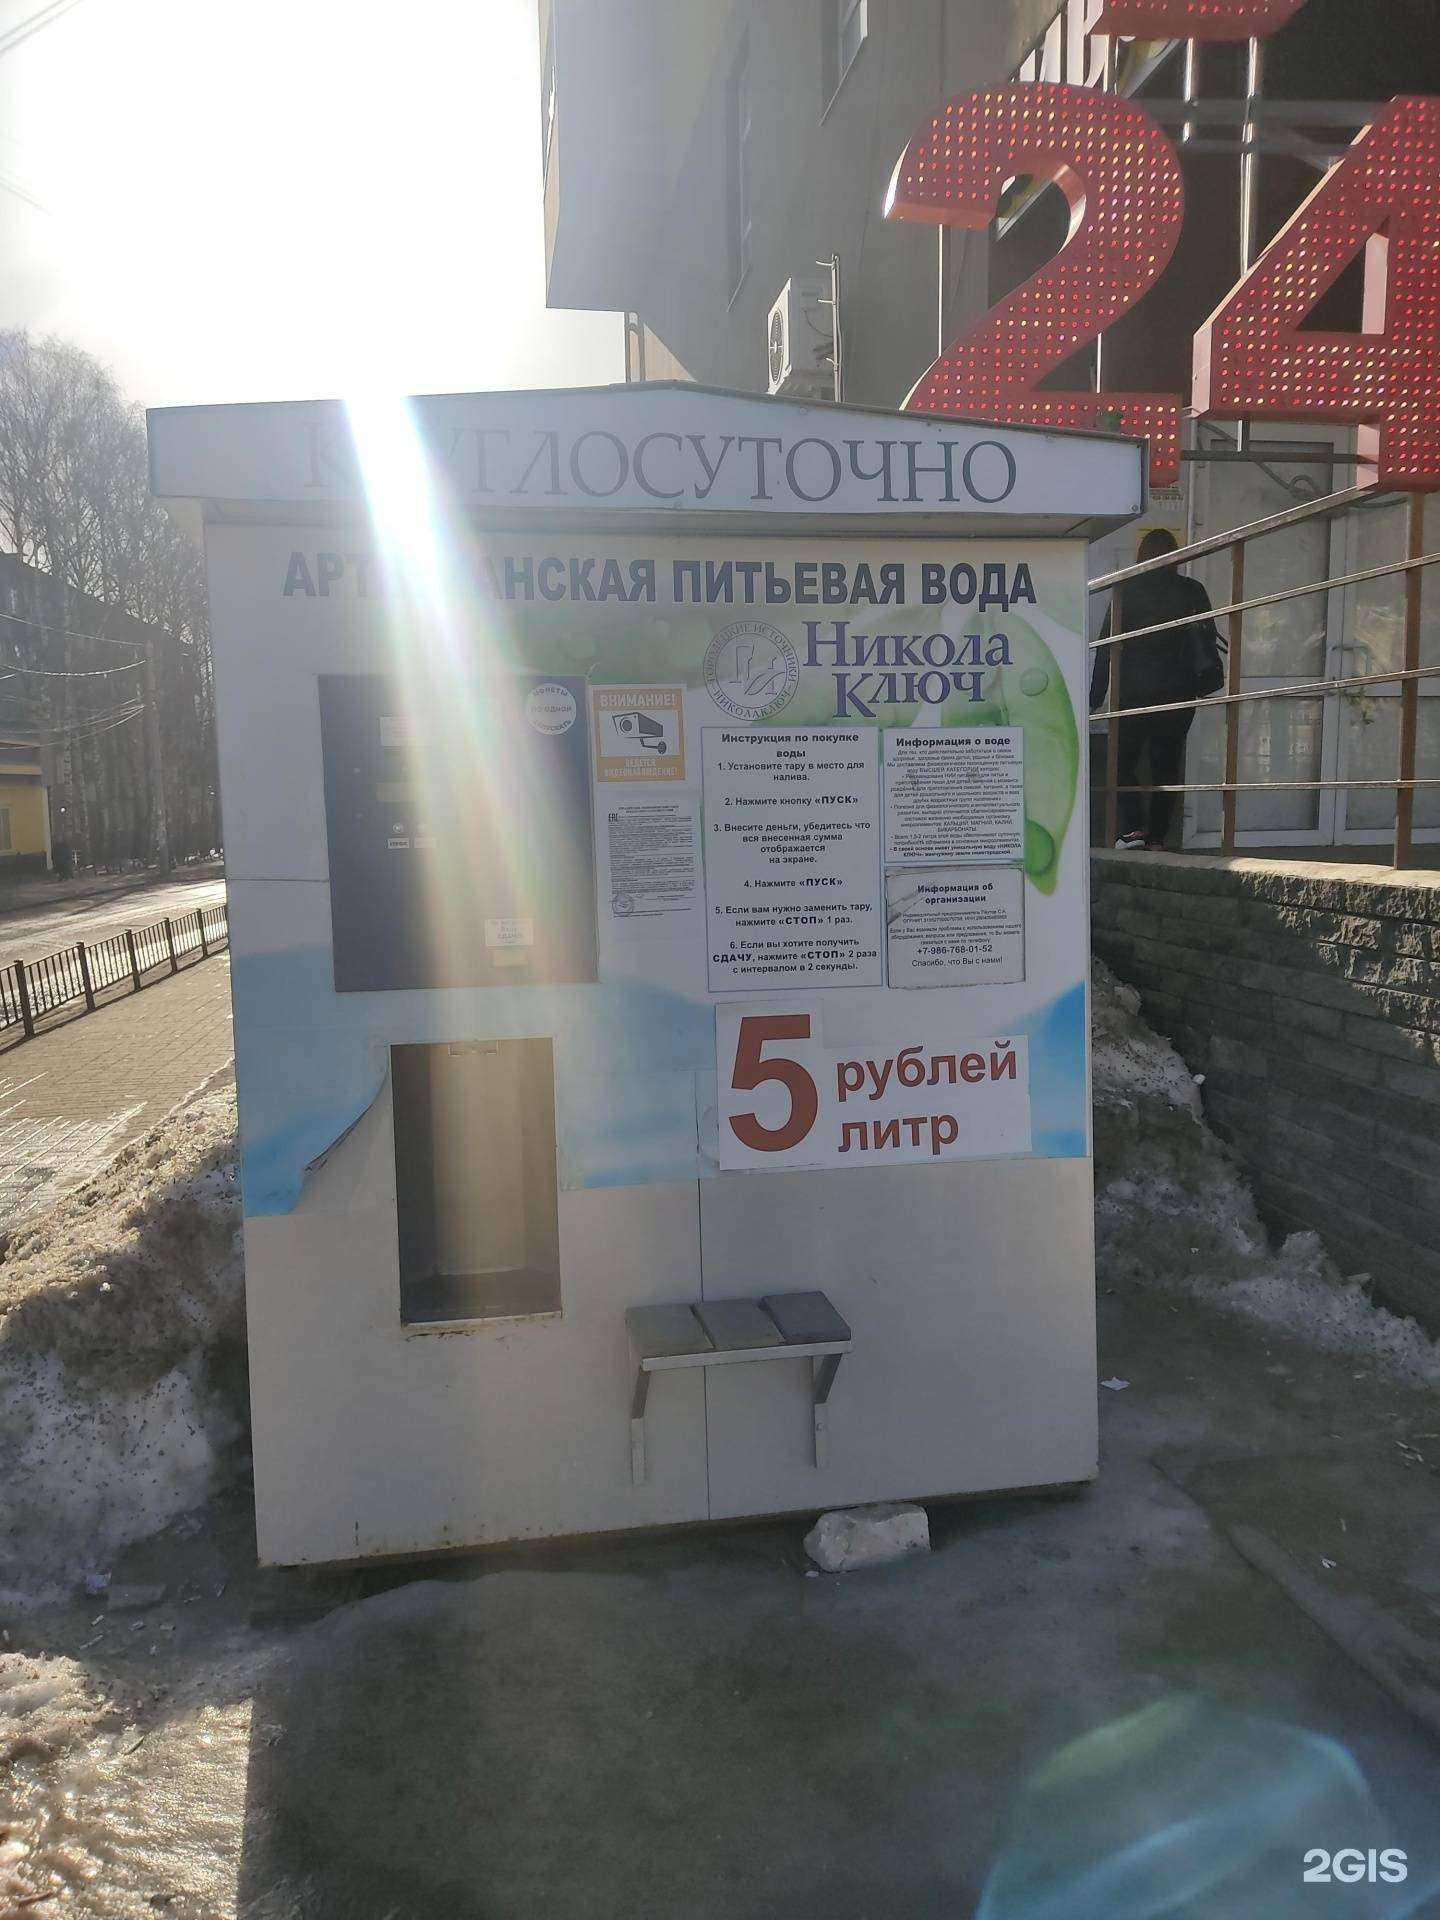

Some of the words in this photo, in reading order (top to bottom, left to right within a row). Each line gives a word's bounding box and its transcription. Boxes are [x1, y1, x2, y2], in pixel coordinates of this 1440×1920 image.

[303, 420, 1017, 504] КГЛОСУТОЧНО
[281, 551, 656, 603] АРТАНСКАЯ
[672, 561, 904, 604] ПИТЬЕВАЯ
[922, 563, 1037, 612] ВОДА
[801, 621, 1013, 667] Никола
[600, 694, 675, 707] ВНИМАНИЕ!
[722, 734, 791, 744] Инструкция
[812, 734, 859, 743] покупке
[896, 738, 971, 747] Информация
[777, 750, 805, 759] воды
[728, 762, 782, 771] Установите
[785, 763, 805, 771] тару
[847, 762, 864, 770] для
[725, 798, 732, 806] 2.
[736, 797, 777, 805] Нажмите
[780, 798, 811, 806] кнопку
[815, 796, 858, 804] «ПУСК»
[714, 824, 722, 832] 3.
[765, 824, 801, 832] деньги,
[804, 822, 852, 831] убедитесь
[762, 834, 811, 842] внесенная
[814, 834, 842, 842] сумма
[761, 845, 825, 854] отображается
[782, 856, 817, 864] экране.
[744, 880, 752, 888] 4.
[755, 880, 795, 888] Нажмите
[799, 878, 843, 886] «ПУСК»
[918, 885, 978, 894] Информация
[983, 883, 993, 891] об
[925, 896, 986, 906] организации
[715, 906, 723, 914] 5.
[726, 906, 749, 914] Если
[772, 905, 801, 913] нужно
[804, 904, 847, 912] заменить
[851, 903, 872, 912] тару,
[779, 917, 823, 925] «СТОП»
[827, 916, 831, 924] 1
[834, 917, 853, 925] раз.
[741, 941, 764, 949] Если
[783, 940, 813, 948] хотите
[816, 939, 859, 947] получить
[917, 945, 993, 954] +7-986-768-01-52
[713, 954, 755, 963] СДАЧУ,
[758, 953, 797, 961] нажмите
[801, 951, 845, 959] «СТОП»
[912, 959, 946, 967] Спасибо,
[981, 956, 1003, 964] нами!
[741, 965, 796, 974] интервалом
[816, 963, 858, 971] секунды.
[728, 1014, 817, 1151] 5
[836, 1040, 1016, 1102] рублей
[838, 1115, 958, 1155] литр
